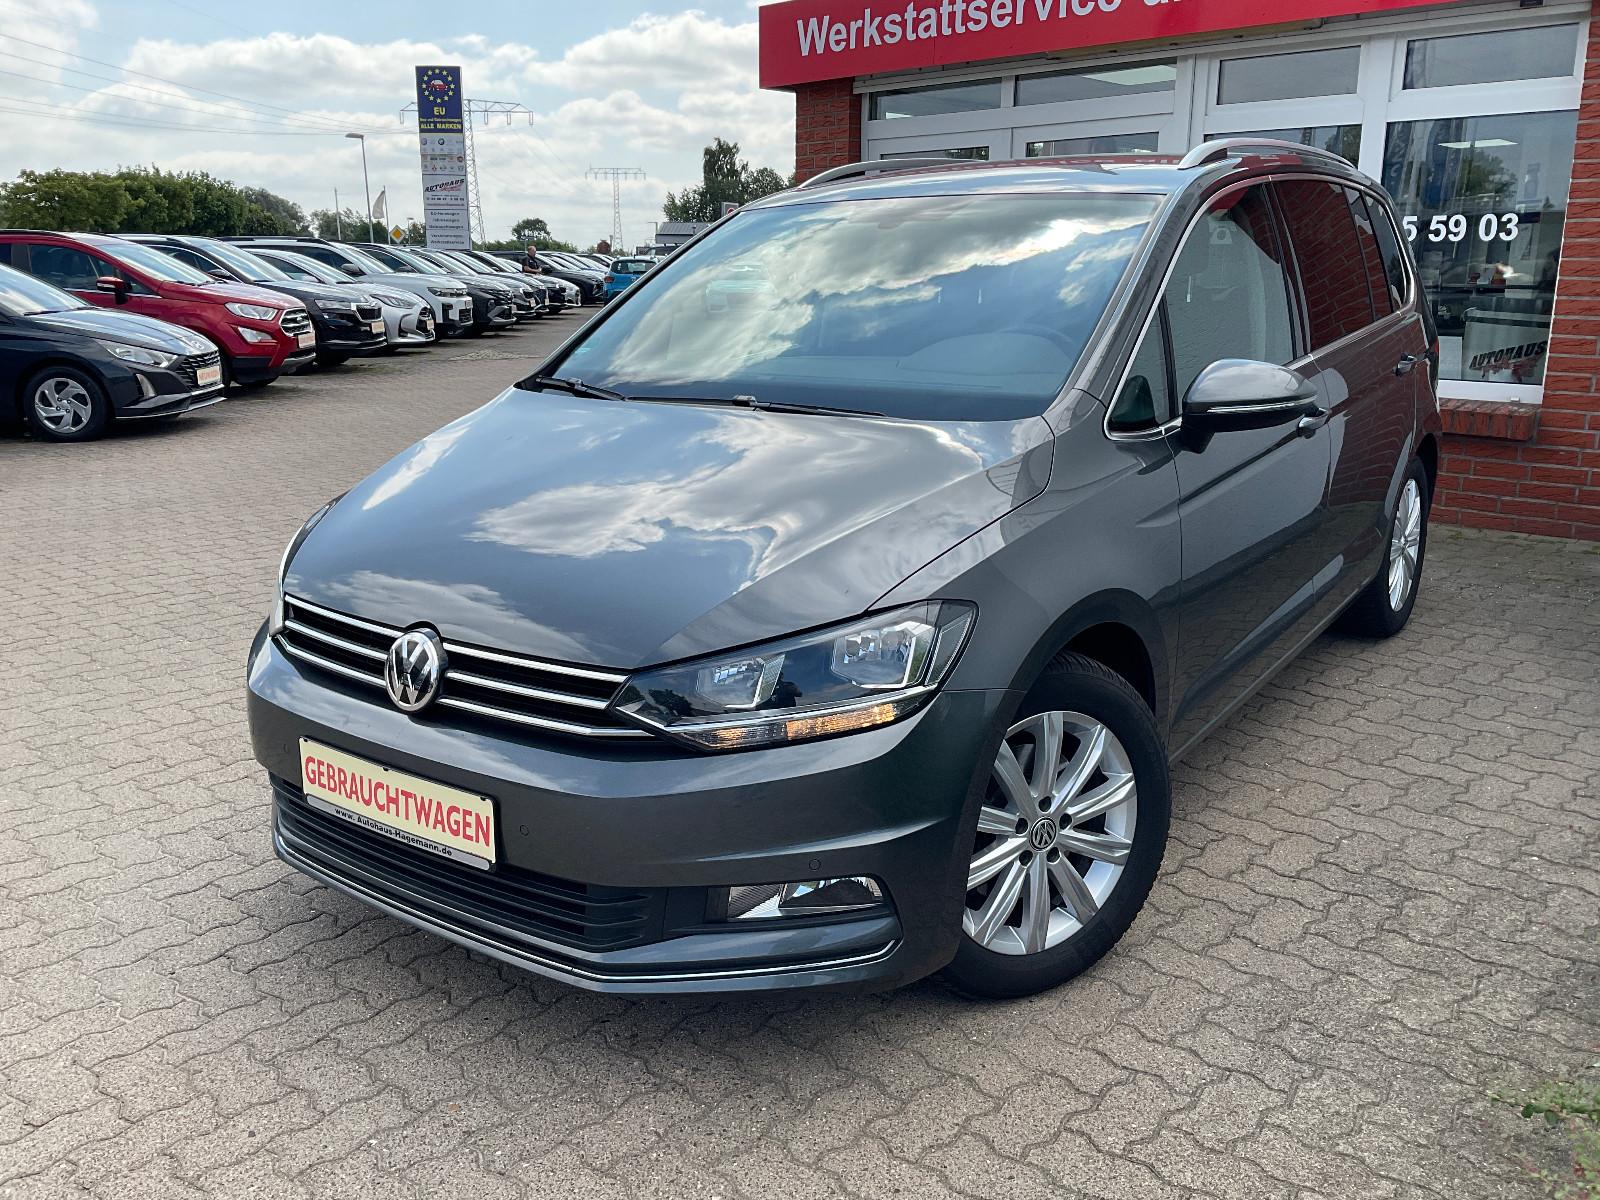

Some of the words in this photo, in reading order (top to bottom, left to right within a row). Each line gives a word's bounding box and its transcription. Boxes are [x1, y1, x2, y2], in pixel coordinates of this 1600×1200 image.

[433, 106, 446, 116] EU
[1402, 215, 1418, 242] 5
[1428, 213, 1467, 242] 59
[1478, 212, 1519, 242] 03
[305, 755, 491, 848] GEBRAUCHTWAGEN
